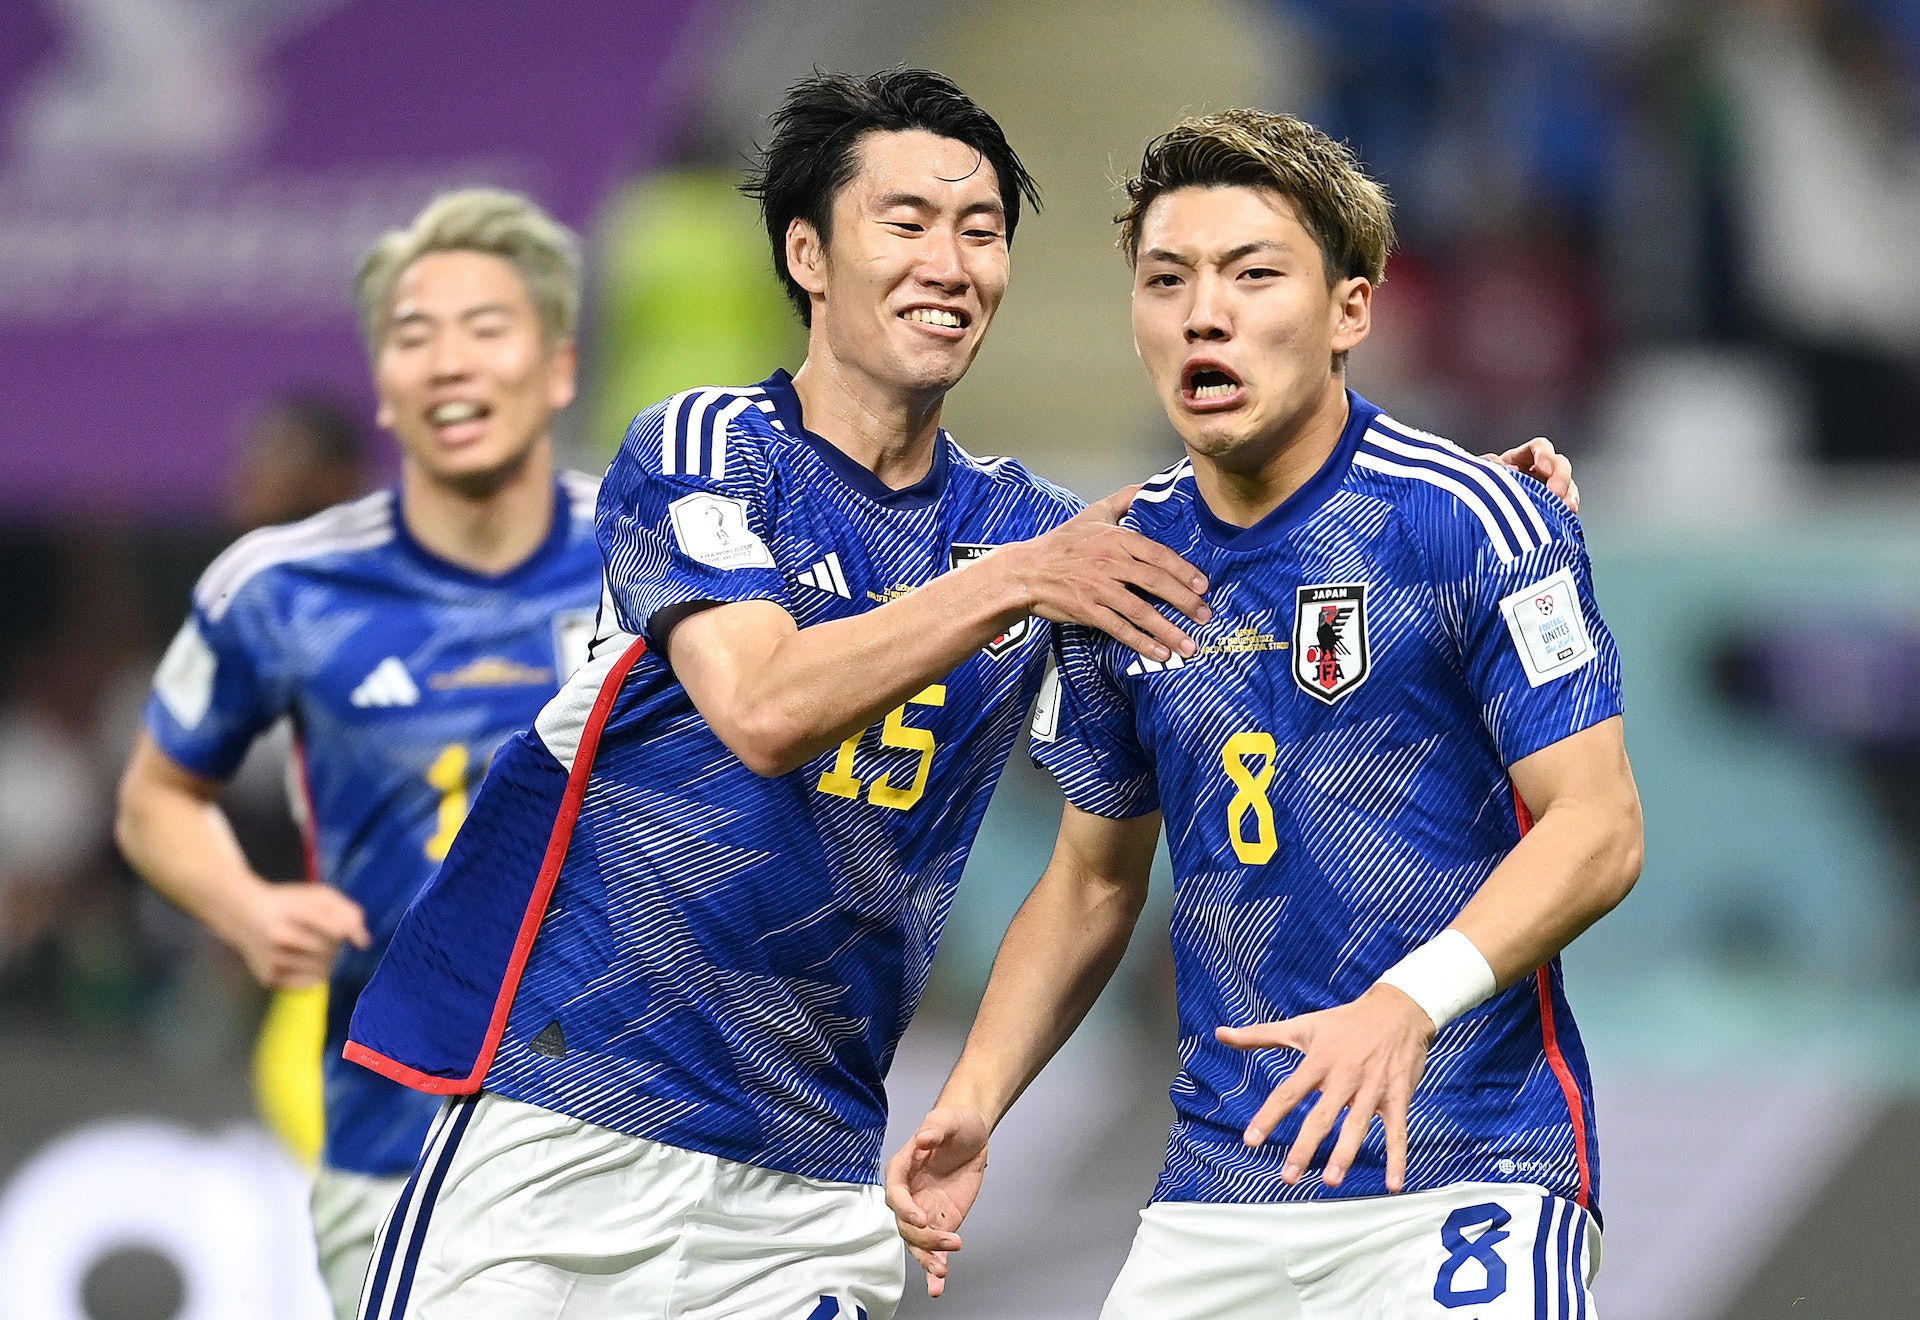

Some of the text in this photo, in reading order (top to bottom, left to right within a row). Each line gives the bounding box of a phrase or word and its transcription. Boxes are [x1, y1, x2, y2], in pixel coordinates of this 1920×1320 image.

[1312, 588, 1348, 600] JAPAN
[1542, 623, 1570, 644] UNITES
[1312, 663, 1345, 682] JFA
[816, 684, 947, 811] 15
[1222, 732, 1278, 865] 8
[424, 743, 474, 863] 1
[1433, 1202, 1512, 1309] 8
